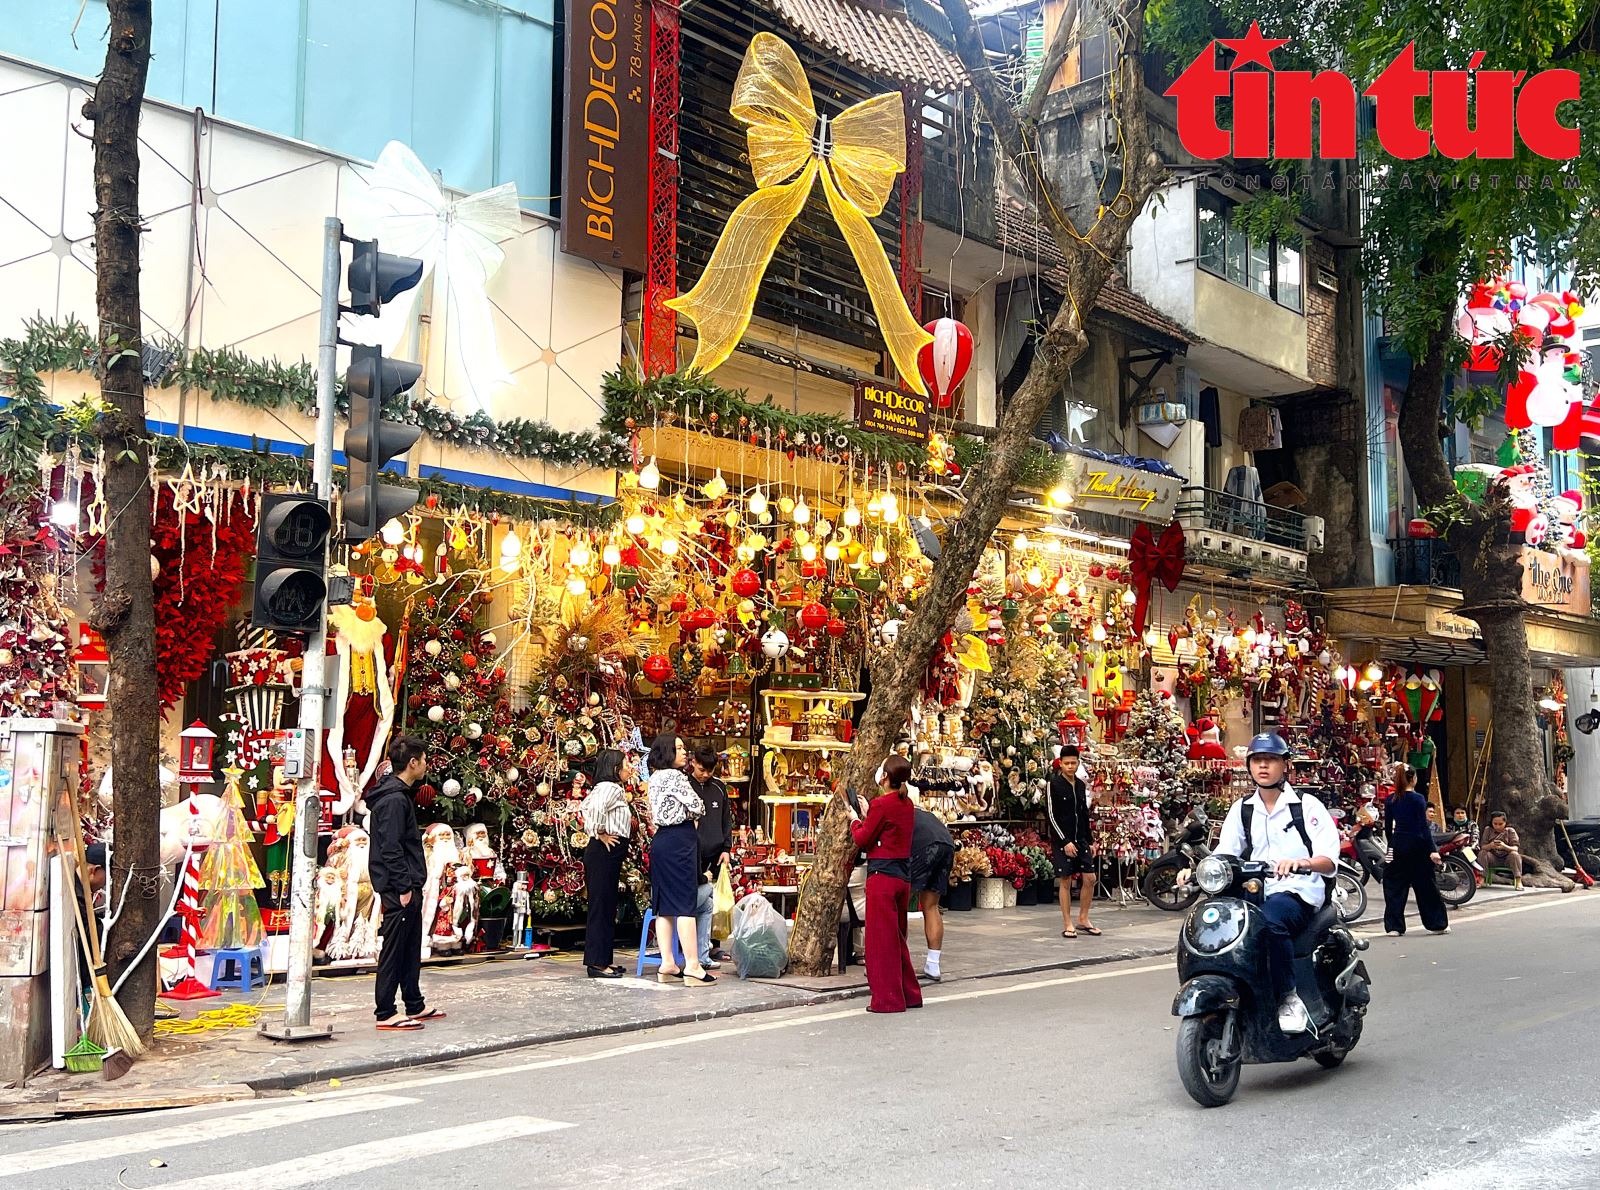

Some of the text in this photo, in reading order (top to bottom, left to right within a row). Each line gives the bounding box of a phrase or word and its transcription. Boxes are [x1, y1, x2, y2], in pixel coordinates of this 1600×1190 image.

[632, 13, 643, 53] HÀNG
[630, 56, 642, 78] 78
[580, 0, 620, 241] BÍCHDECO
[864, 386, 926, 414] BÍCHDECOR
[873, 408, 918, 428] 78 HÀNG MÃ
[1084, 471, 1123, 494] Thanh
[1529, 556, 1573, 595] The One
